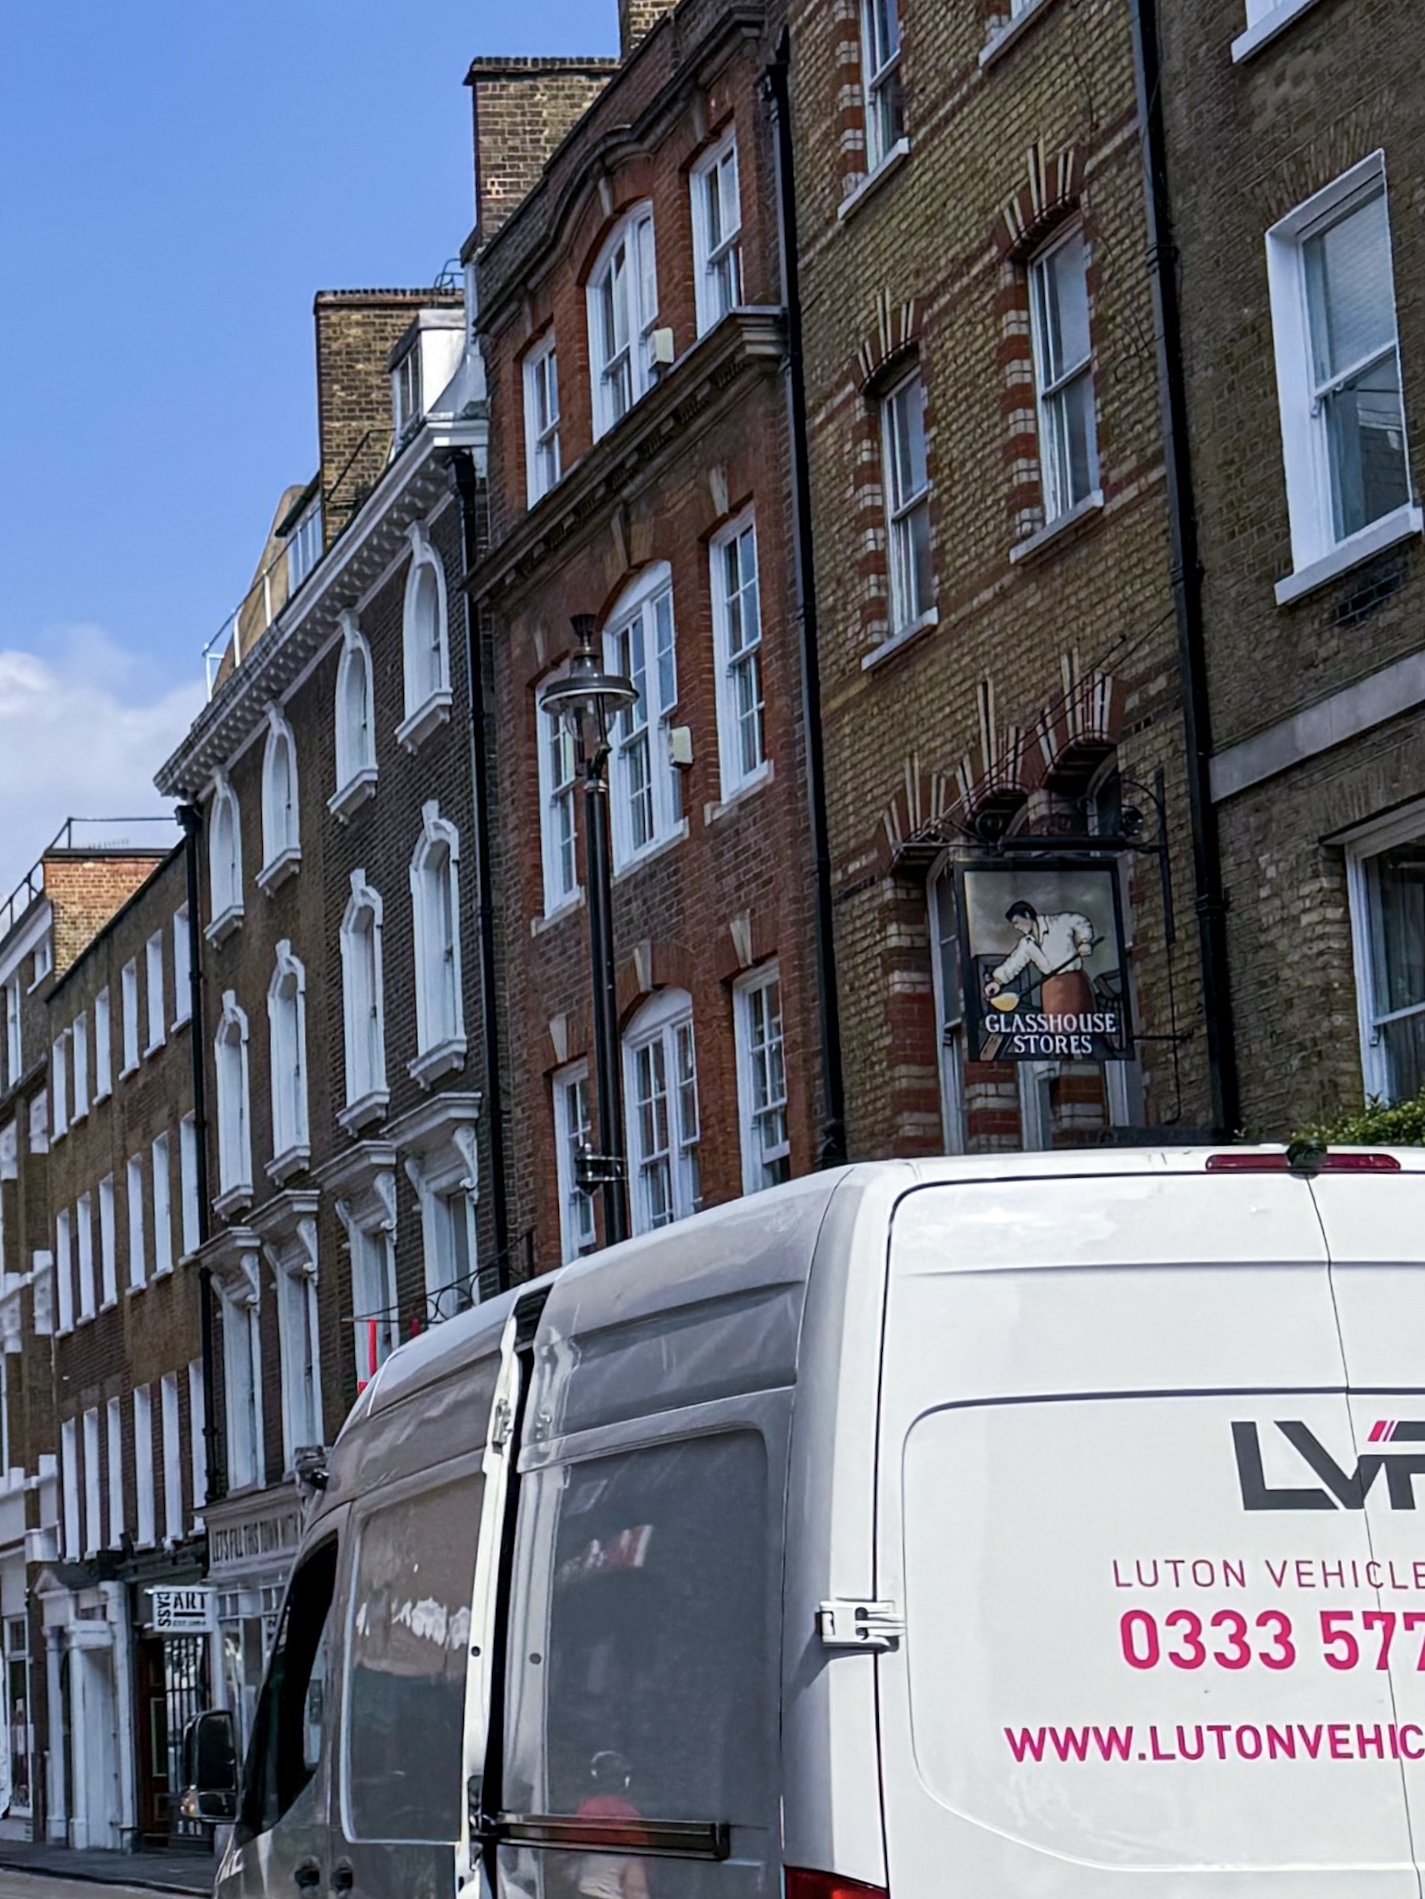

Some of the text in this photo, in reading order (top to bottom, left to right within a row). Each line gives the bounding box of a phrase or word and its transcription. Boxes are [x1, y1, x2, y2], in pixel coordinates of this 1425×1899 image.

[984, 1013, 1116, 1033] GLASSHOUSE
[1013, 1034, 1093, 1054] STORES
[1112, 1559, 1425, 1590] LUTON VEHICLE
[173, 1591, 208, 1609] ART
[1119, 1609, 1296, 1671] 0333
[1004, 1723, 1425, 1763] WWW.LUTONVEHIC
